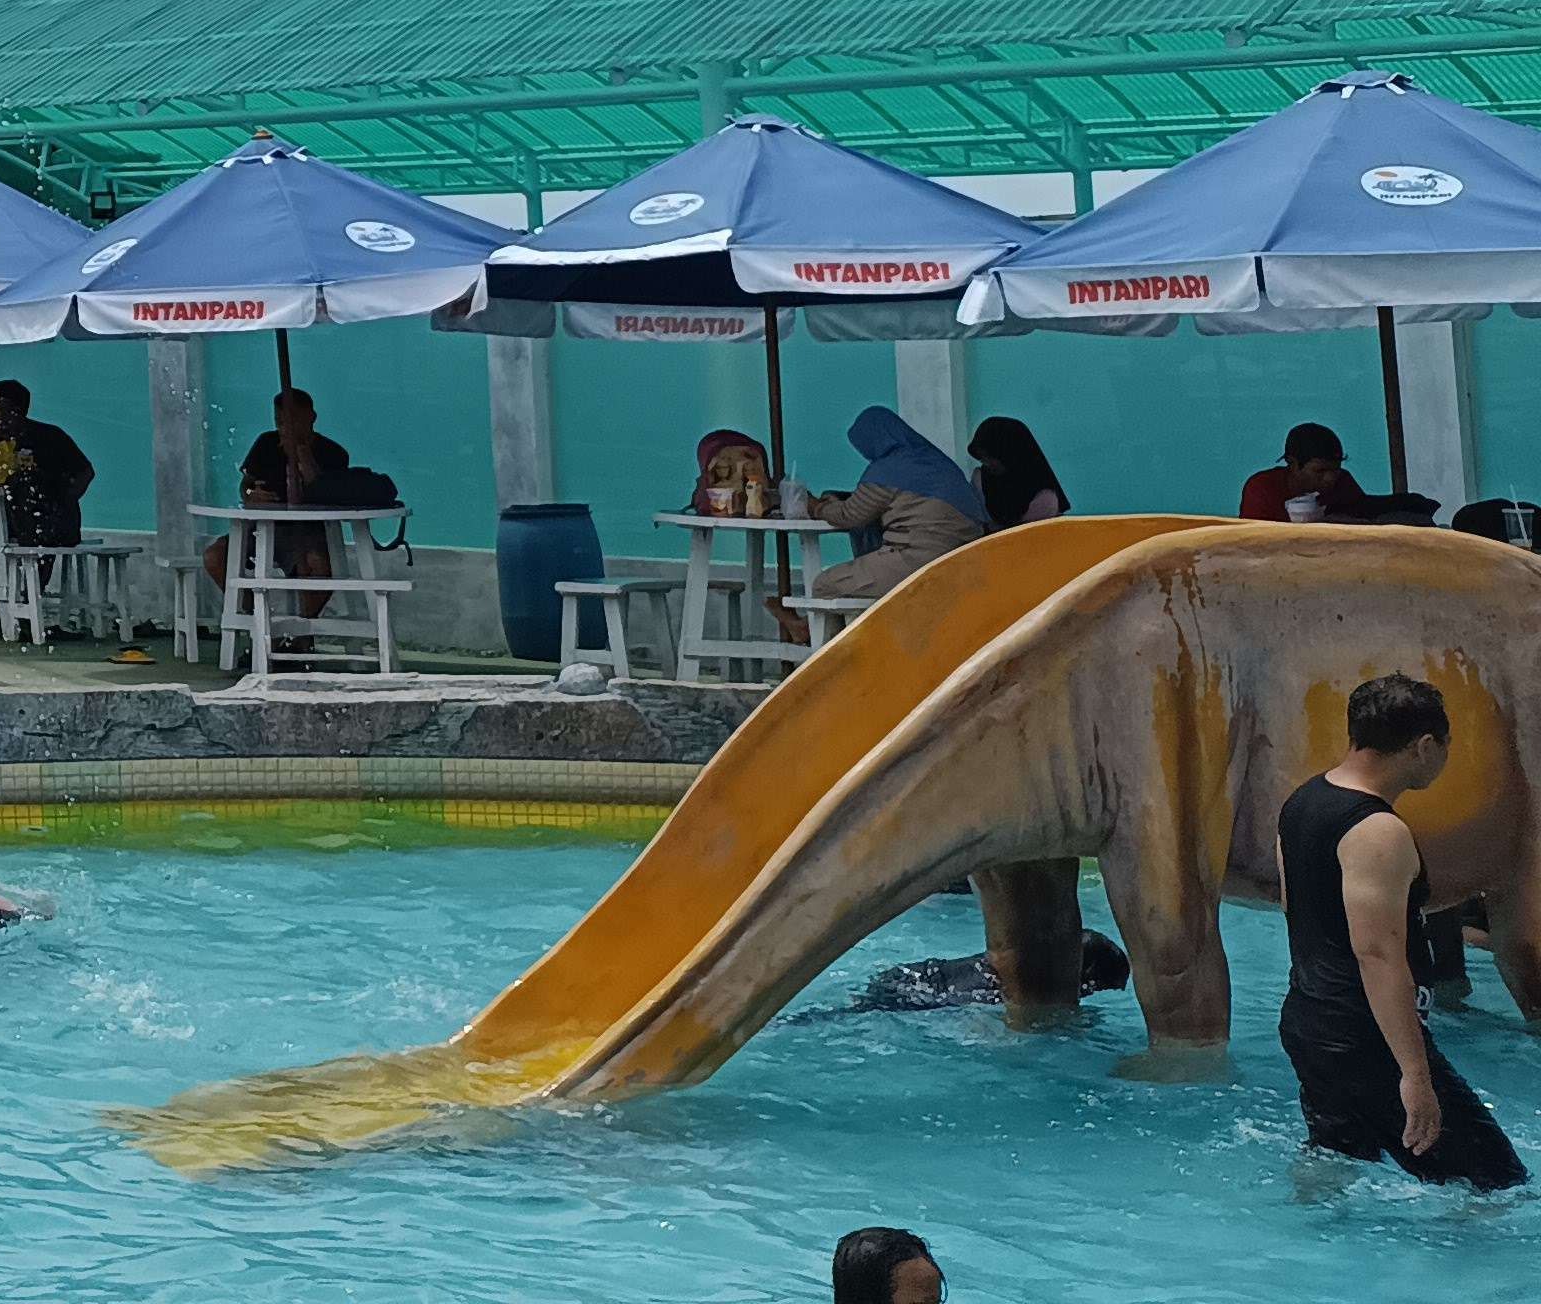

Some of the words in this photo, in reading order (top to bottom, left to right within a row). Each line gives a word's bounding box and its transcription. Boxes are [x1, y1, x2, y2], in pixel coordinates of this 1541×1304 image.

[793, 262, 950, 284] INTANPARI
[1068, 274, 1211, 304] INTANPARI
[132, 300, 264, 322] INTANPARI
